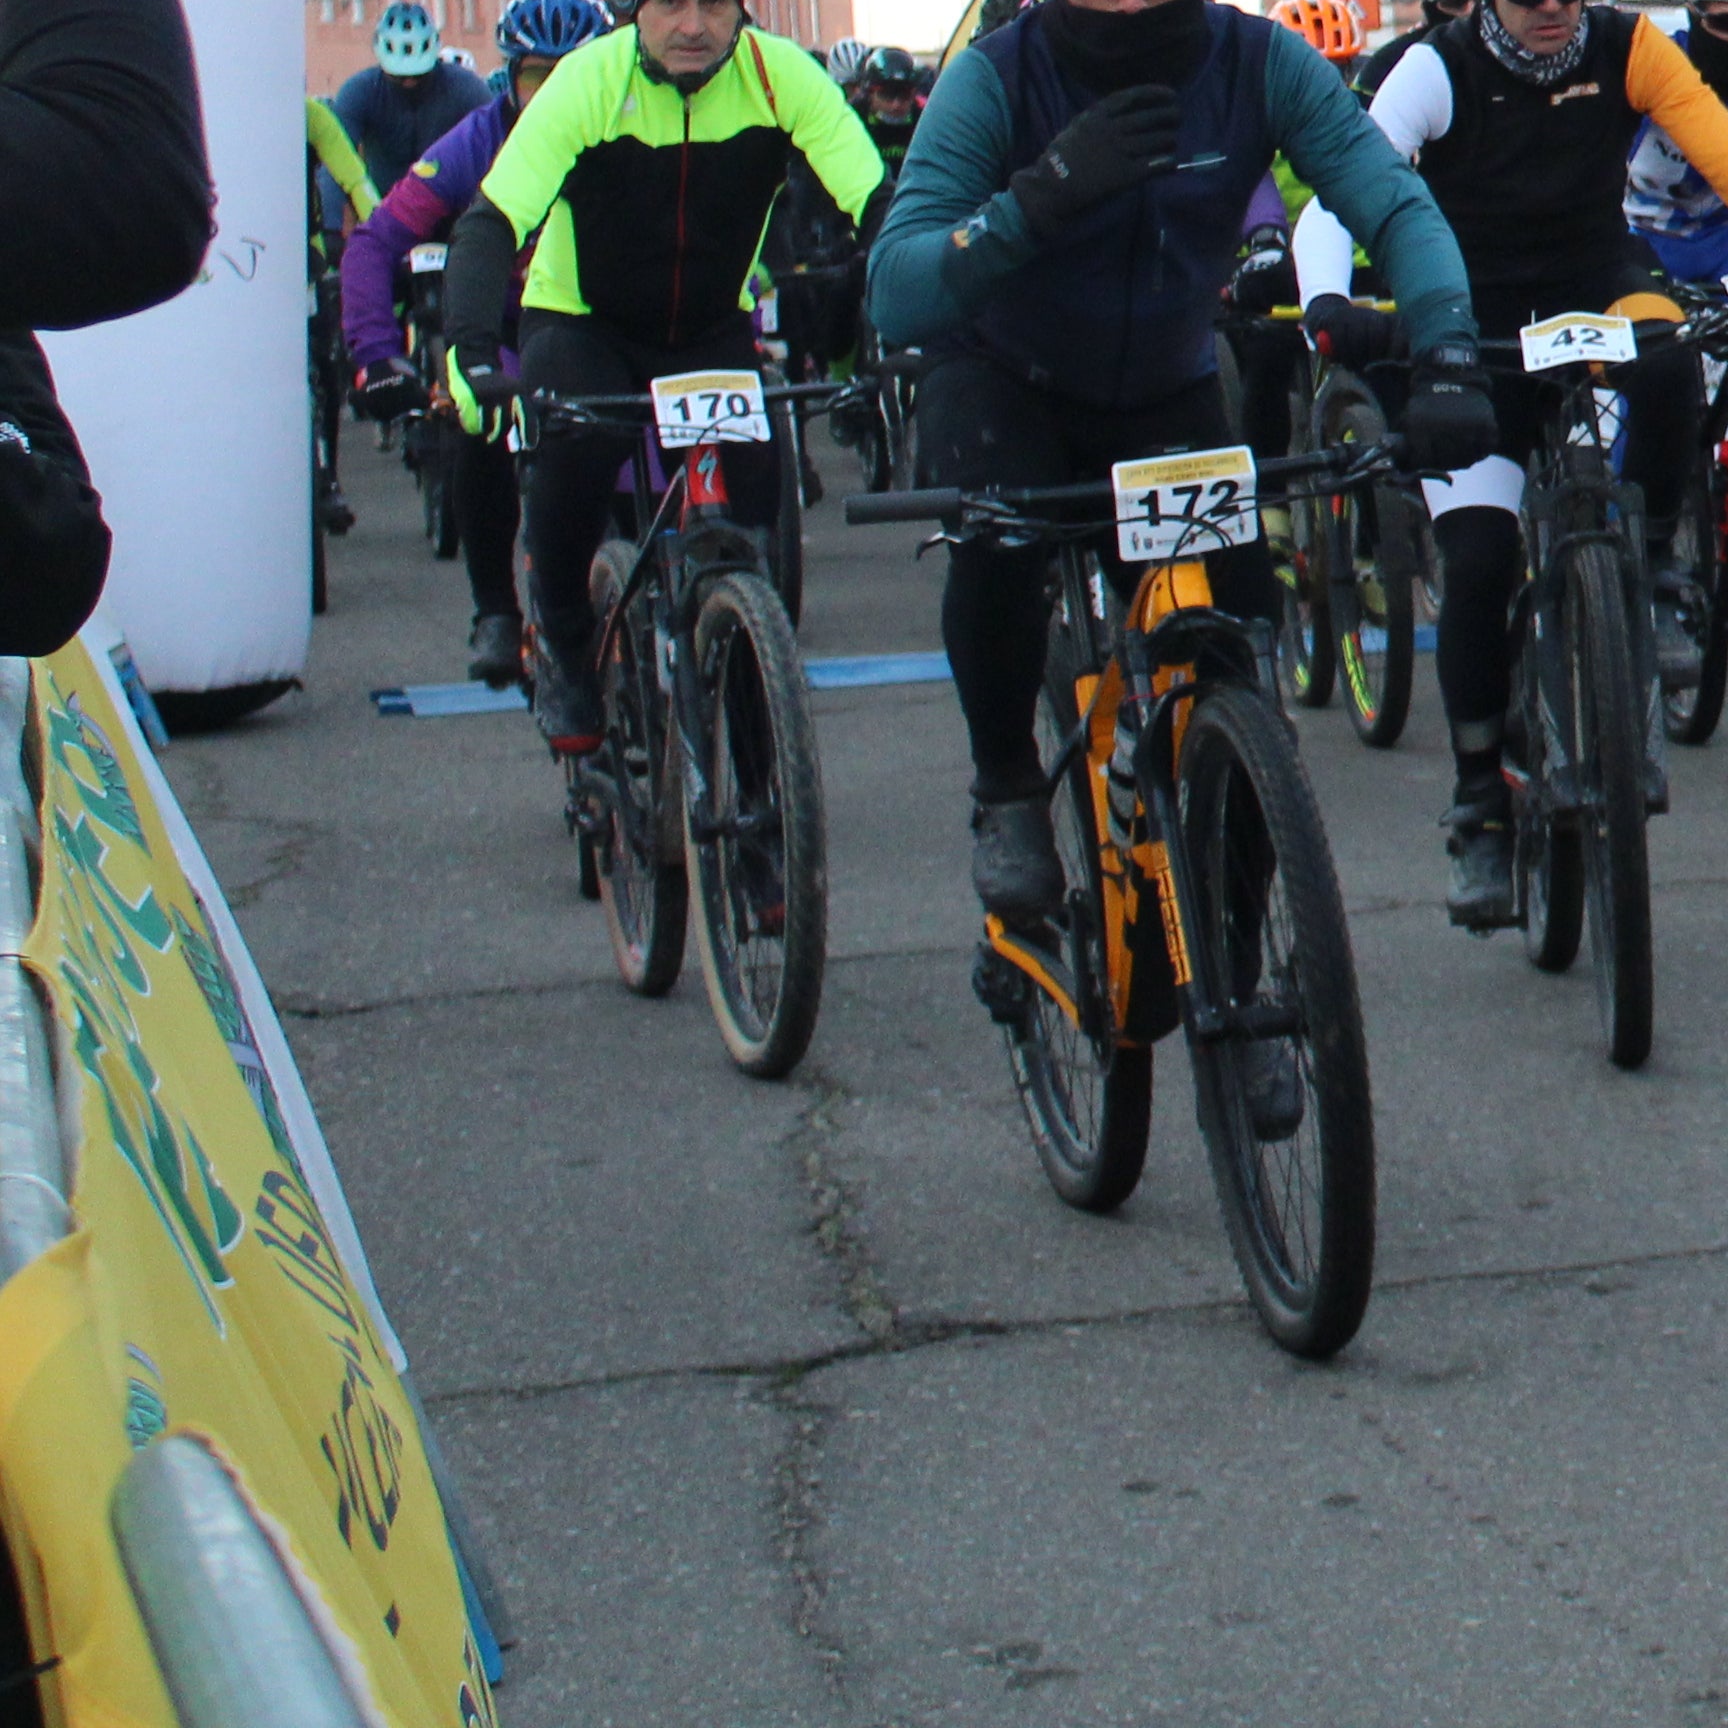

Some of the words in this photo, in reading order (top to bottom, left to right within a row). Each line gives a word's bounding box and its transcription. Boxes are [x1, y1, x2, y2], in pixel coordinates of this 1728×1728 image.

[1551, 326, 1607, 348] 42
[673, 392, 751, 422] 170
[1138, 479, 1242, 527] 172
